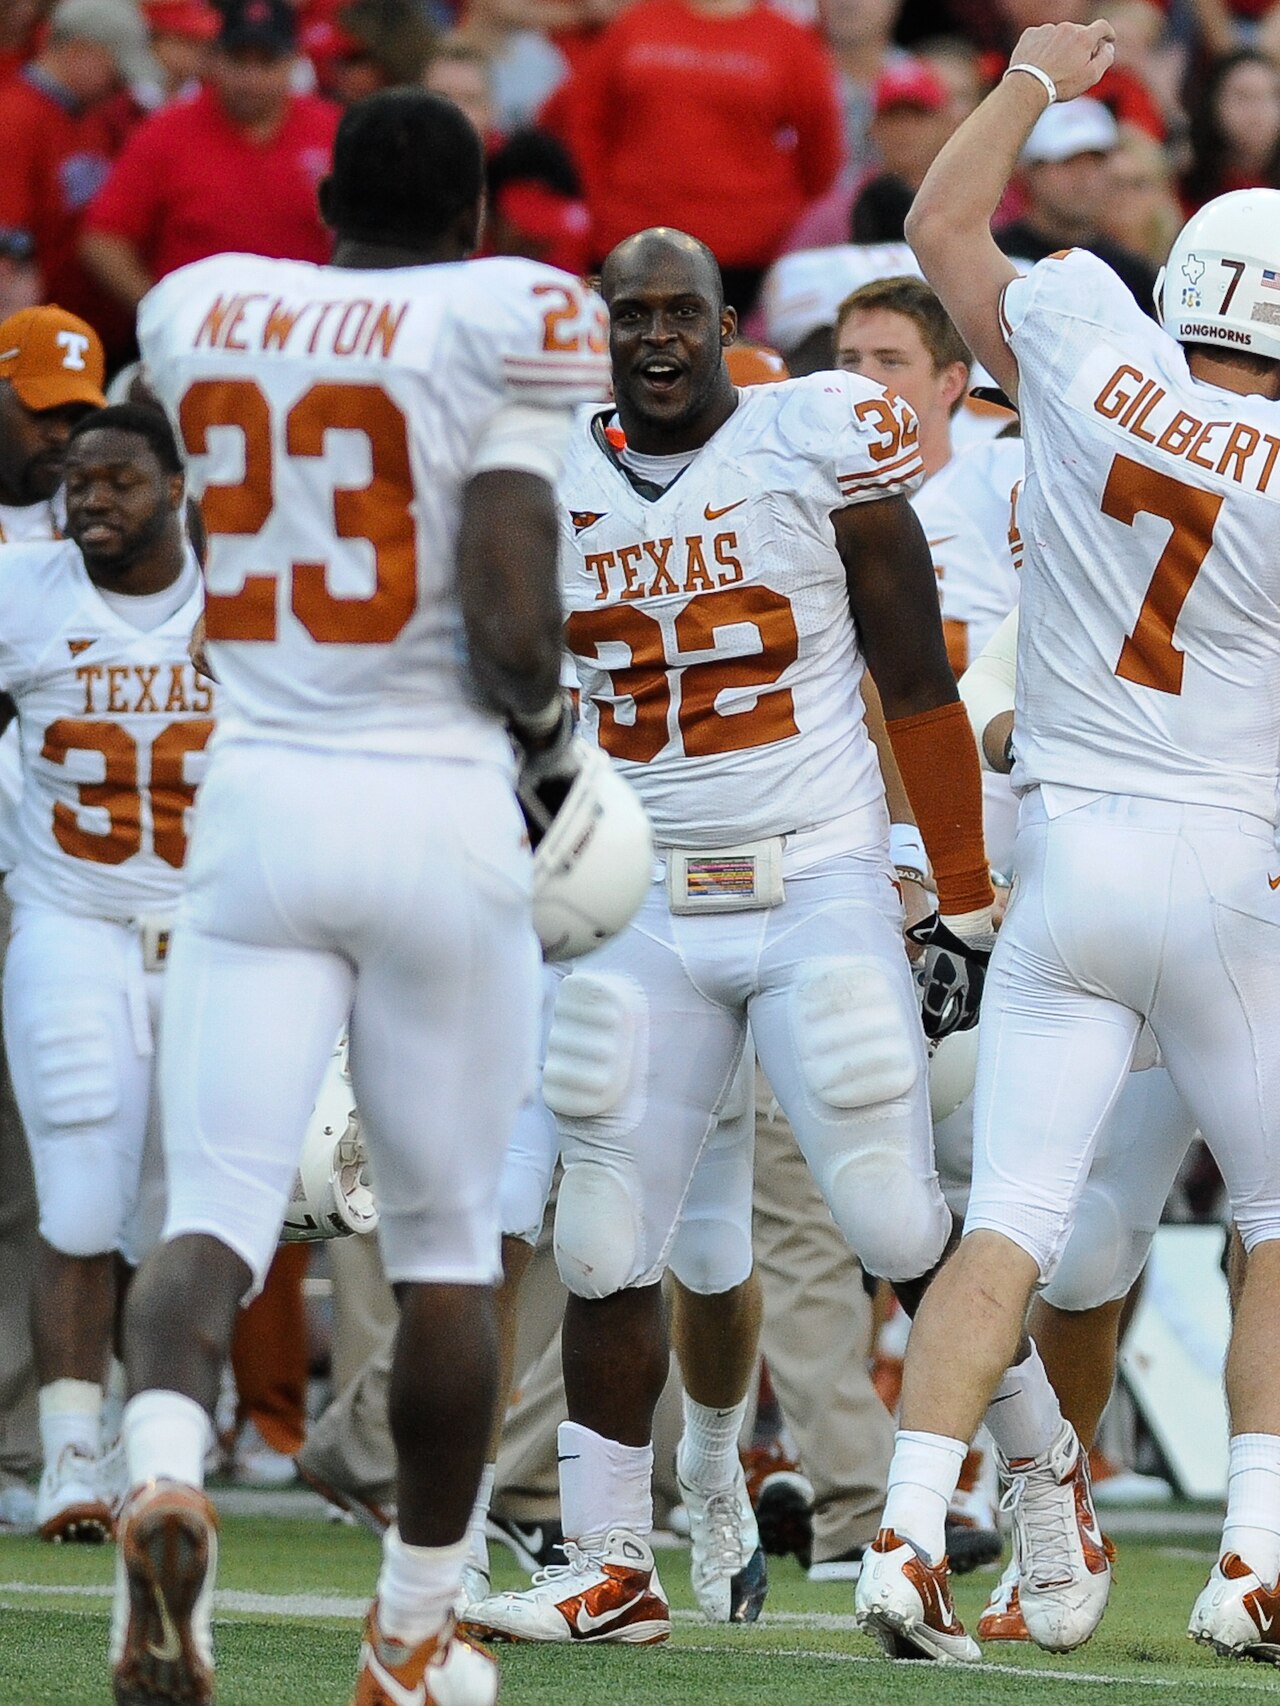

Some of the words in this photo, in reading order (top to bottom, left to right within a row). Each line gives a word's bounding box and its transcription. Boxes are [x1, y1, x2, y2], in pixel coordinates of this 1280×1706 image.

[1219, 258, 1246, 316] 7
[56, 331, 89, 370] T
[194, 292, 410, 359] NEWTON
[1180, 324, 1252, 345] LONGHORNS
[179, 377, 418, 645] 23
[585, 531, 745, 601] TEXAS
[1100, 452, 1224, 696] 7
[76, 664, 215, 714] TEXAS
[564, 584, 801, 764] 32
